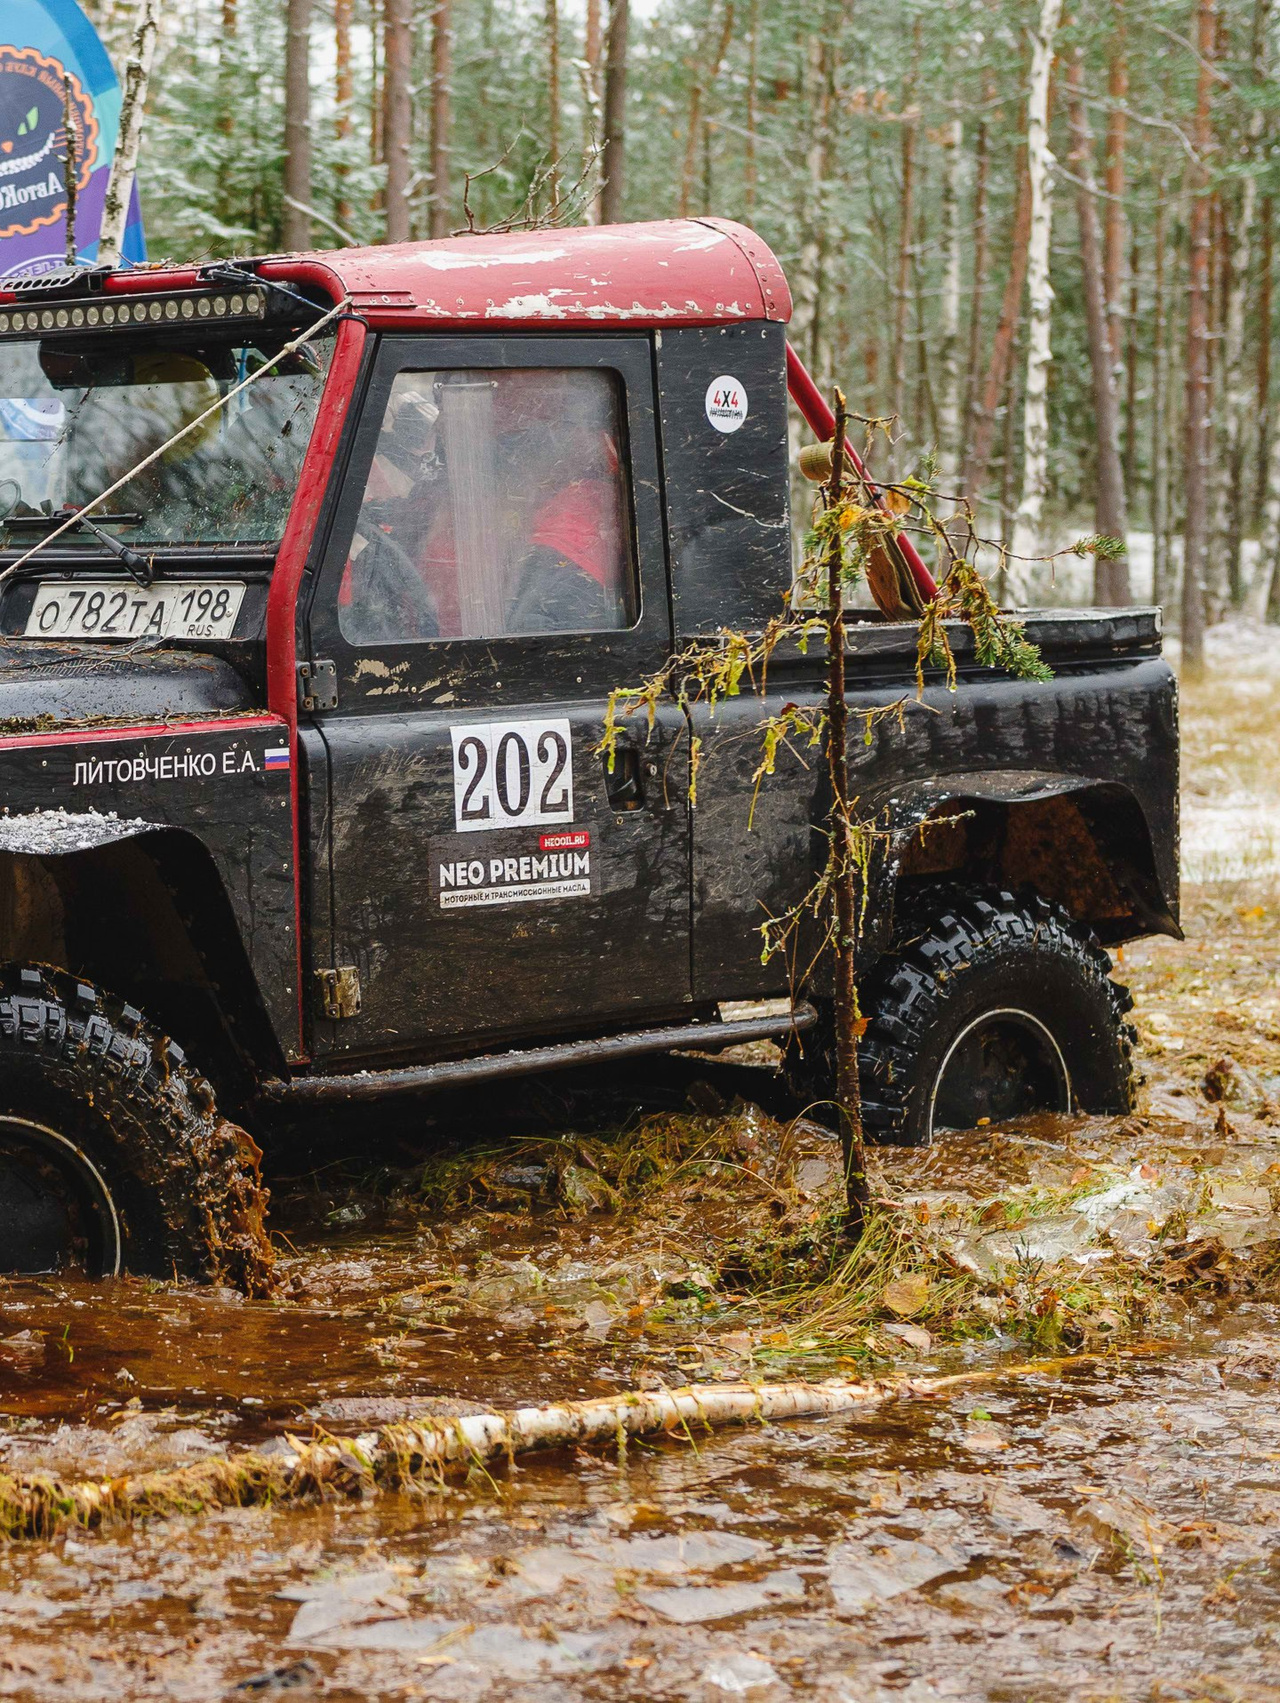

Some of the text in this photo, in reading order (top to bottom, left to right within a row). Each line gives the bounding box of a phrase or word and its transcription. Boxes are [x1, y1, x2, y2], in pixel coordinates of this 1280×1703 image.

[181, 588, 230, 623] 198
[73, 750, 261, 786] ЛИТОВЧЕНКО Е.А.
[458, 730, 569, 821] 202
[439, 851, 590, 888] NEO PREMIUM
[491, 886, 562, 899] ТРАНСМИССИОННЫЕ
